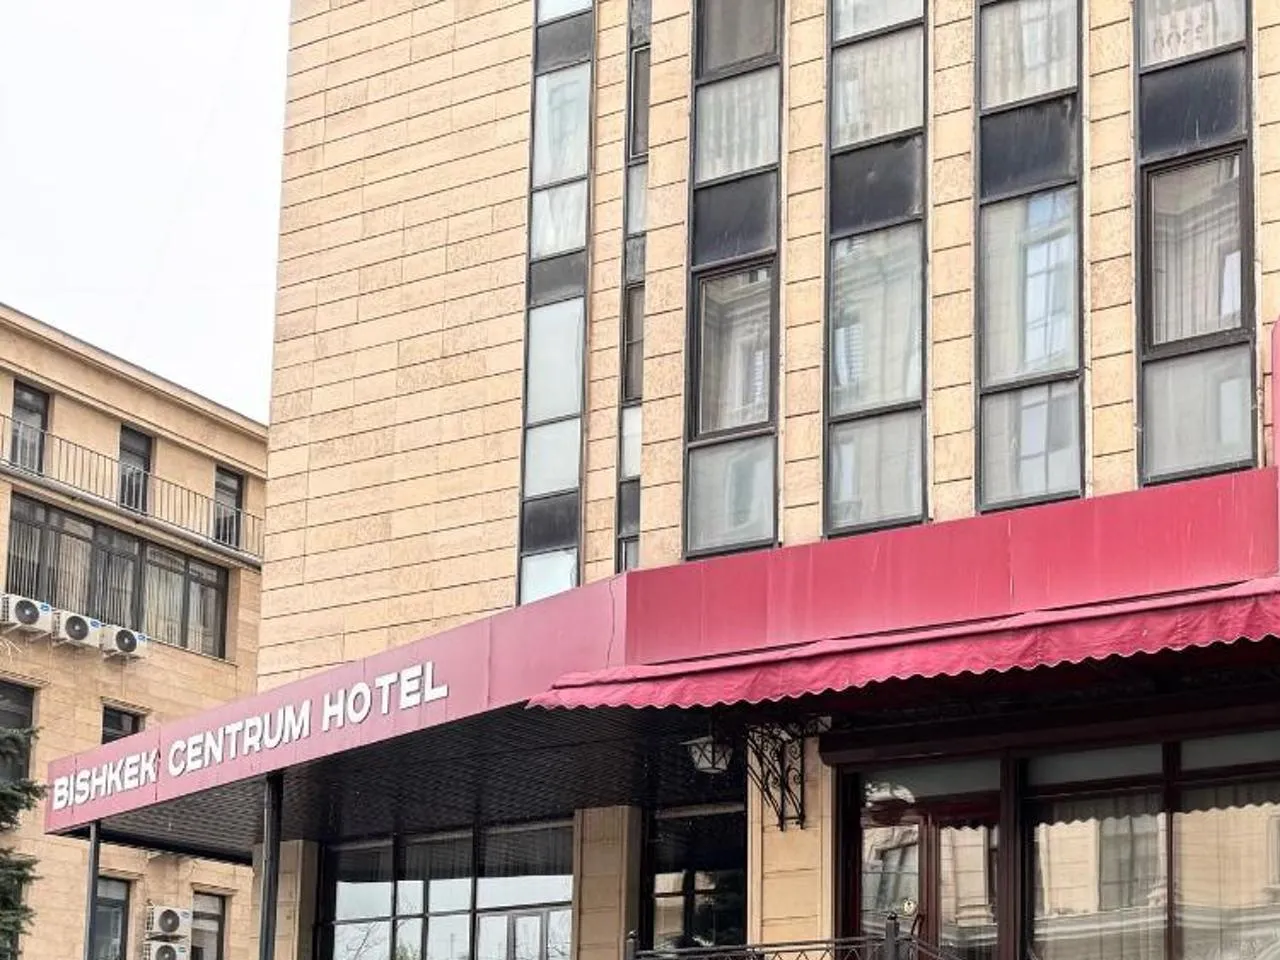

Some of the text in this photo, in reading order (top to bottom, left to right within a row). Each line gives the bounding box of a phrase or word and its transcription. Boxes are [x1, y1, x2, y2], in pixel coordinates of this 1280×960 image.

[52, 660, 450, 811] BISHKEK CENTRUM HOTEL
